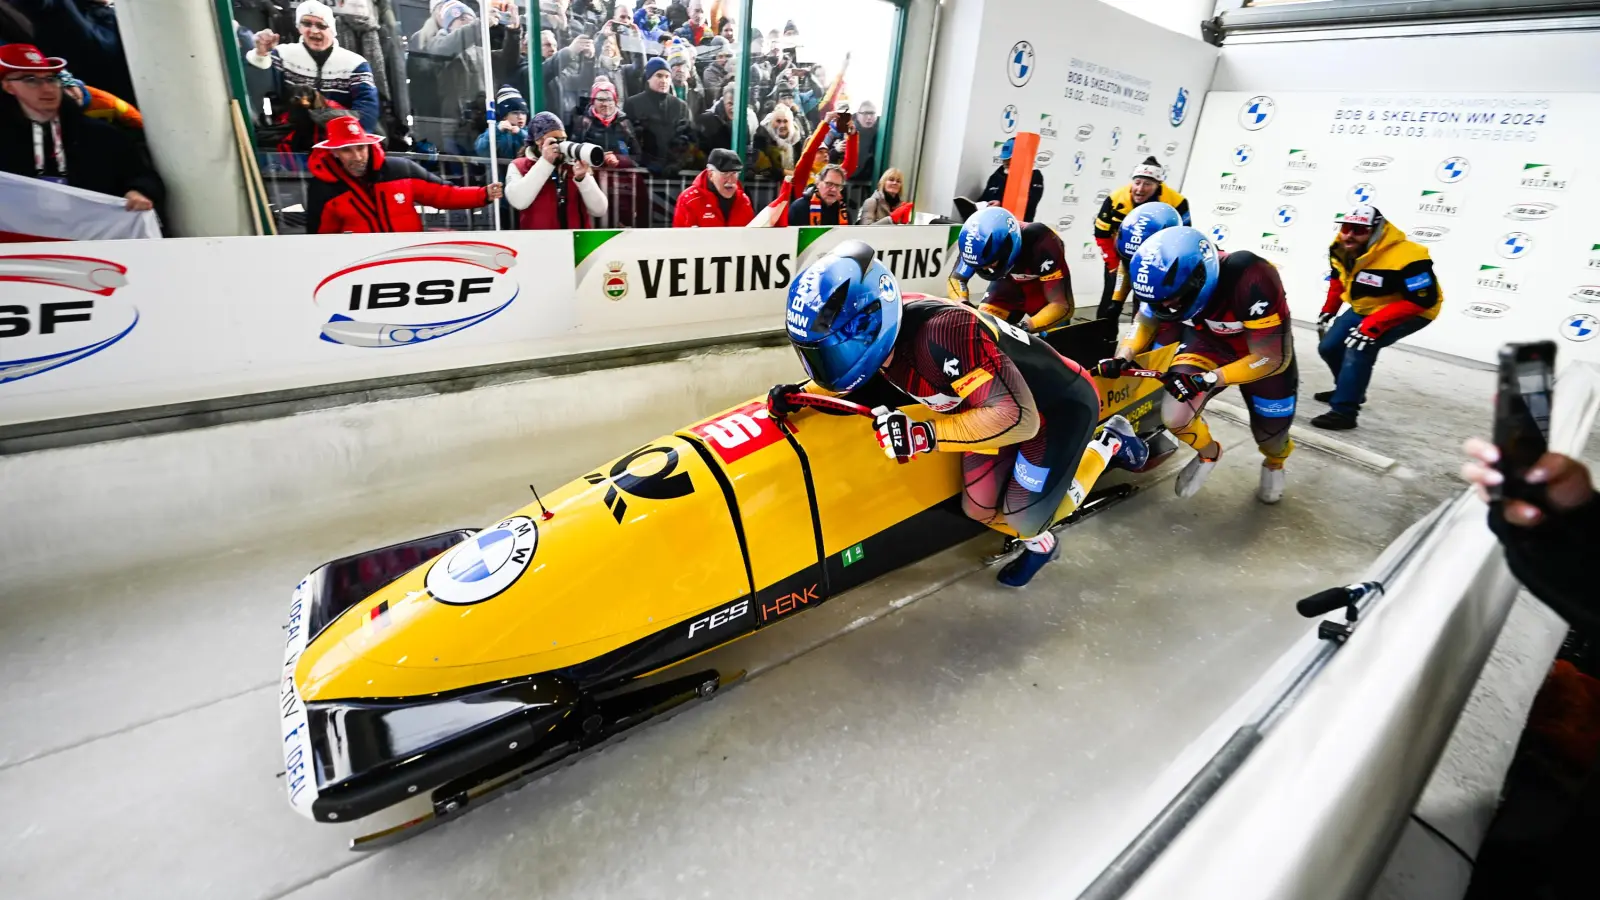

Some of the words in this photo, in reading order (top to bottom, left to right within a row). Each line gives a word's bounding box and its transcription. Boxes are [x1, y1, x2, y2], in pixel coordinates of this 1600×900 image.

[1067, 71, 1083, 85] BOB
[1090, 77, 1122, 95] SKELETON
[1133, 90, 1150, 102] 2024
[1334, 109, 1363, 120] BOB
[1367, 110, 1375, 121] &
[1381, 110, 1460, 123] SKELETON
[1466, 112, 1496, 124] WM
[1500, 113, 1547, 126] 2024
[1521, 178, 1567, 189] VELTINS
[1418, 203, 1458, 214] VELTINS
[1131, 215, 1152, 244] BMW
[638, 253, 791, 299] VELTINS
[879, 247, 942, 280] TINS
[348, 277, 494, 311] IBSF
[1133, 281, 1154, 293] BMW
[1477, 278, 1518, 291] VELTINS
[0, 300, 94, 339] SF
[787, 308, 809, 328] BMW
[1107, 384, 1130, 408] Post
[1174, 379, 1189, 396] SEIZ
[890, 421, 904, 447] SEIZ
[762, 583, 820, 621] HENK
[286, 598, 302, 648] IDEAL
[688, 599, 749, 639] FES
[286, 744, 306, 807] IDEAL
